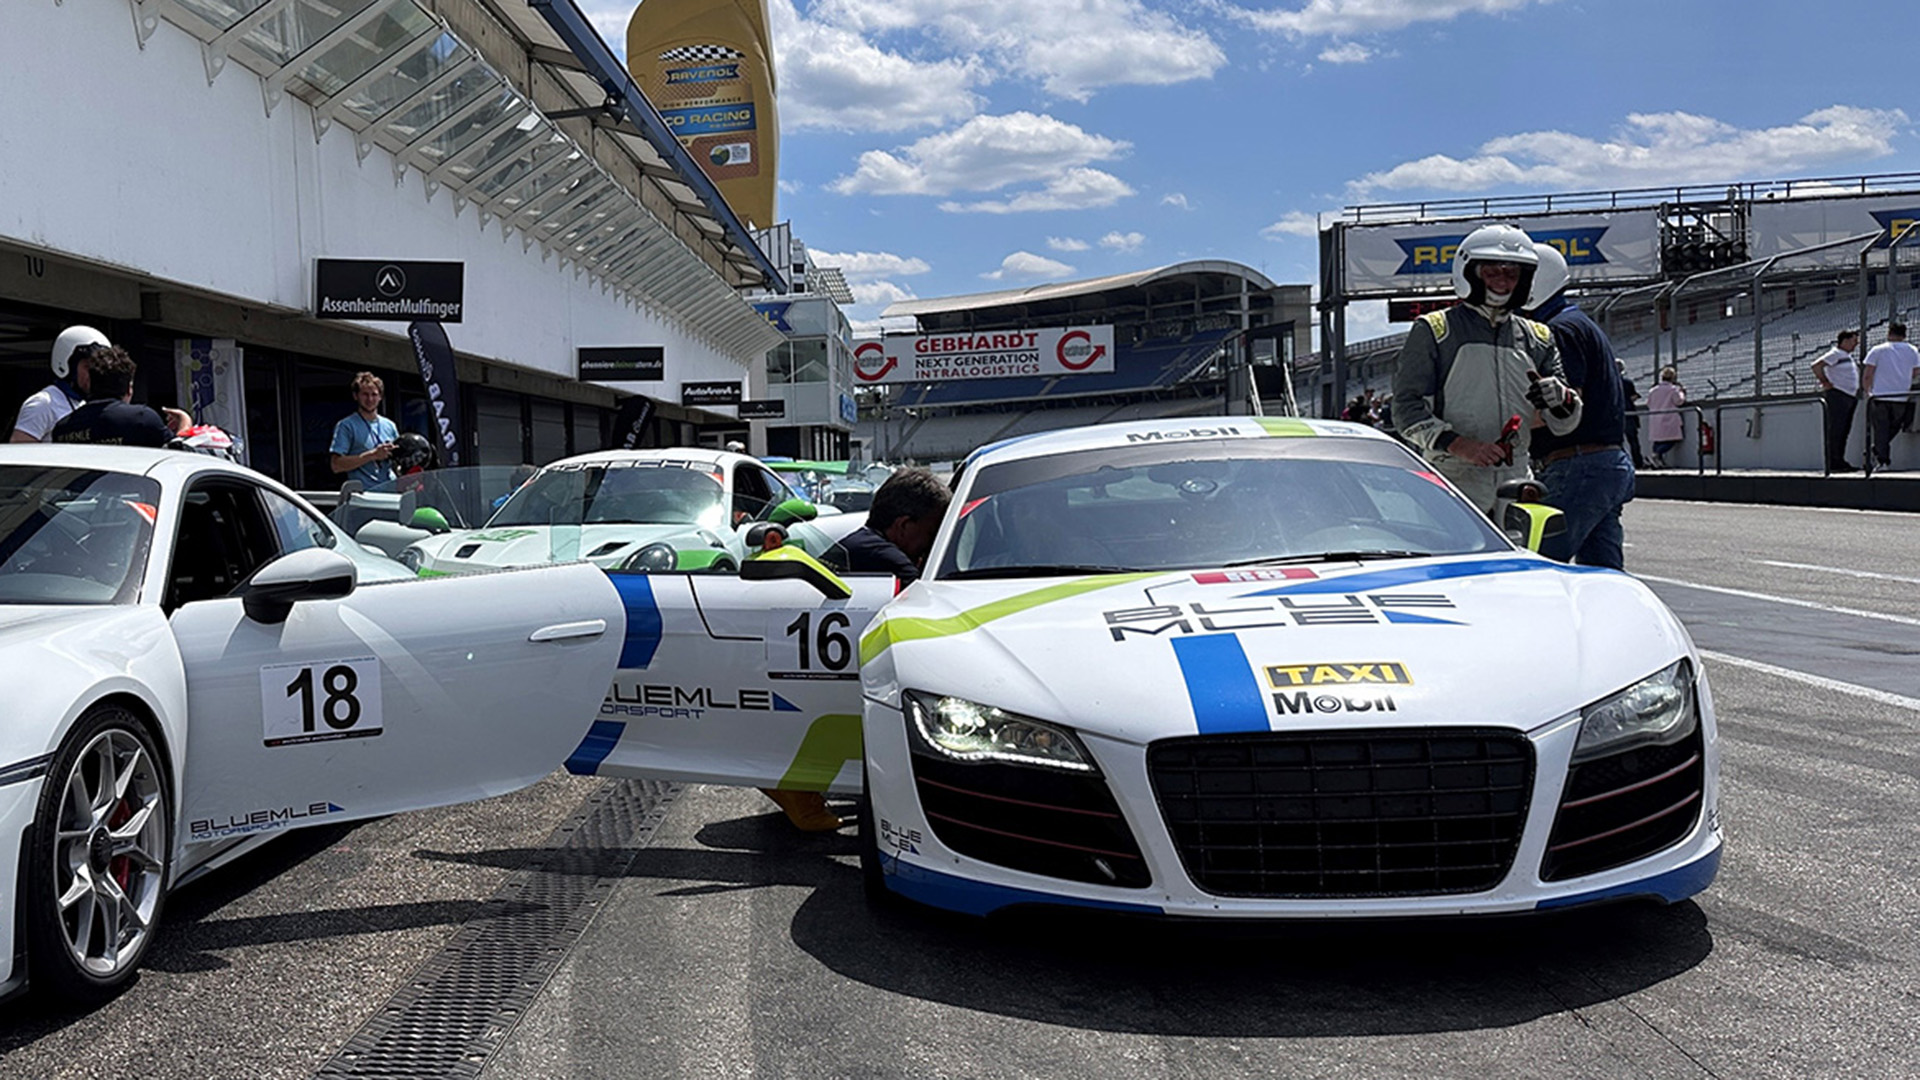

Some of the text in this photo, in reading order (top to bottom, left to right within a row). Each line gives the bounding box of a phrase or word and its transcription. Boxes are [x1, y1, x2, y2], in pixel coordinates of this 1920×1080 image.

[671, 68, 734, 81] RAVENOL
[690, 109, 751, 124] RACING
[321, 296, 460, 318] AssenheimerMulfinger
[914, 333, 1039, 354] GEBHARDT
[915, 353, 1039, 369] NEXT GENERATION
[915, 363, 1040, 379] INTRALOGISTICS
[1126, 427, 1240, 443] Mobil
[1102, 594, 1457, 625] BLUE
[1109, 609, 1380, 642] MLE
[786, 611, 852, 671] 16
[1274, 663, 1399, 685] TAXI
[286, 664, 361, 733] 18
[604, 683, 770, 711] UEMLE
[1272, 690, 1397, 717] Mobil
[190, 802, 327, 833] BLUEMLE
[191, 819, 290, 841] MOTORSPORT
[880, 818, 922, 844] BLUE
[880, 830, 910, 852] MLE
